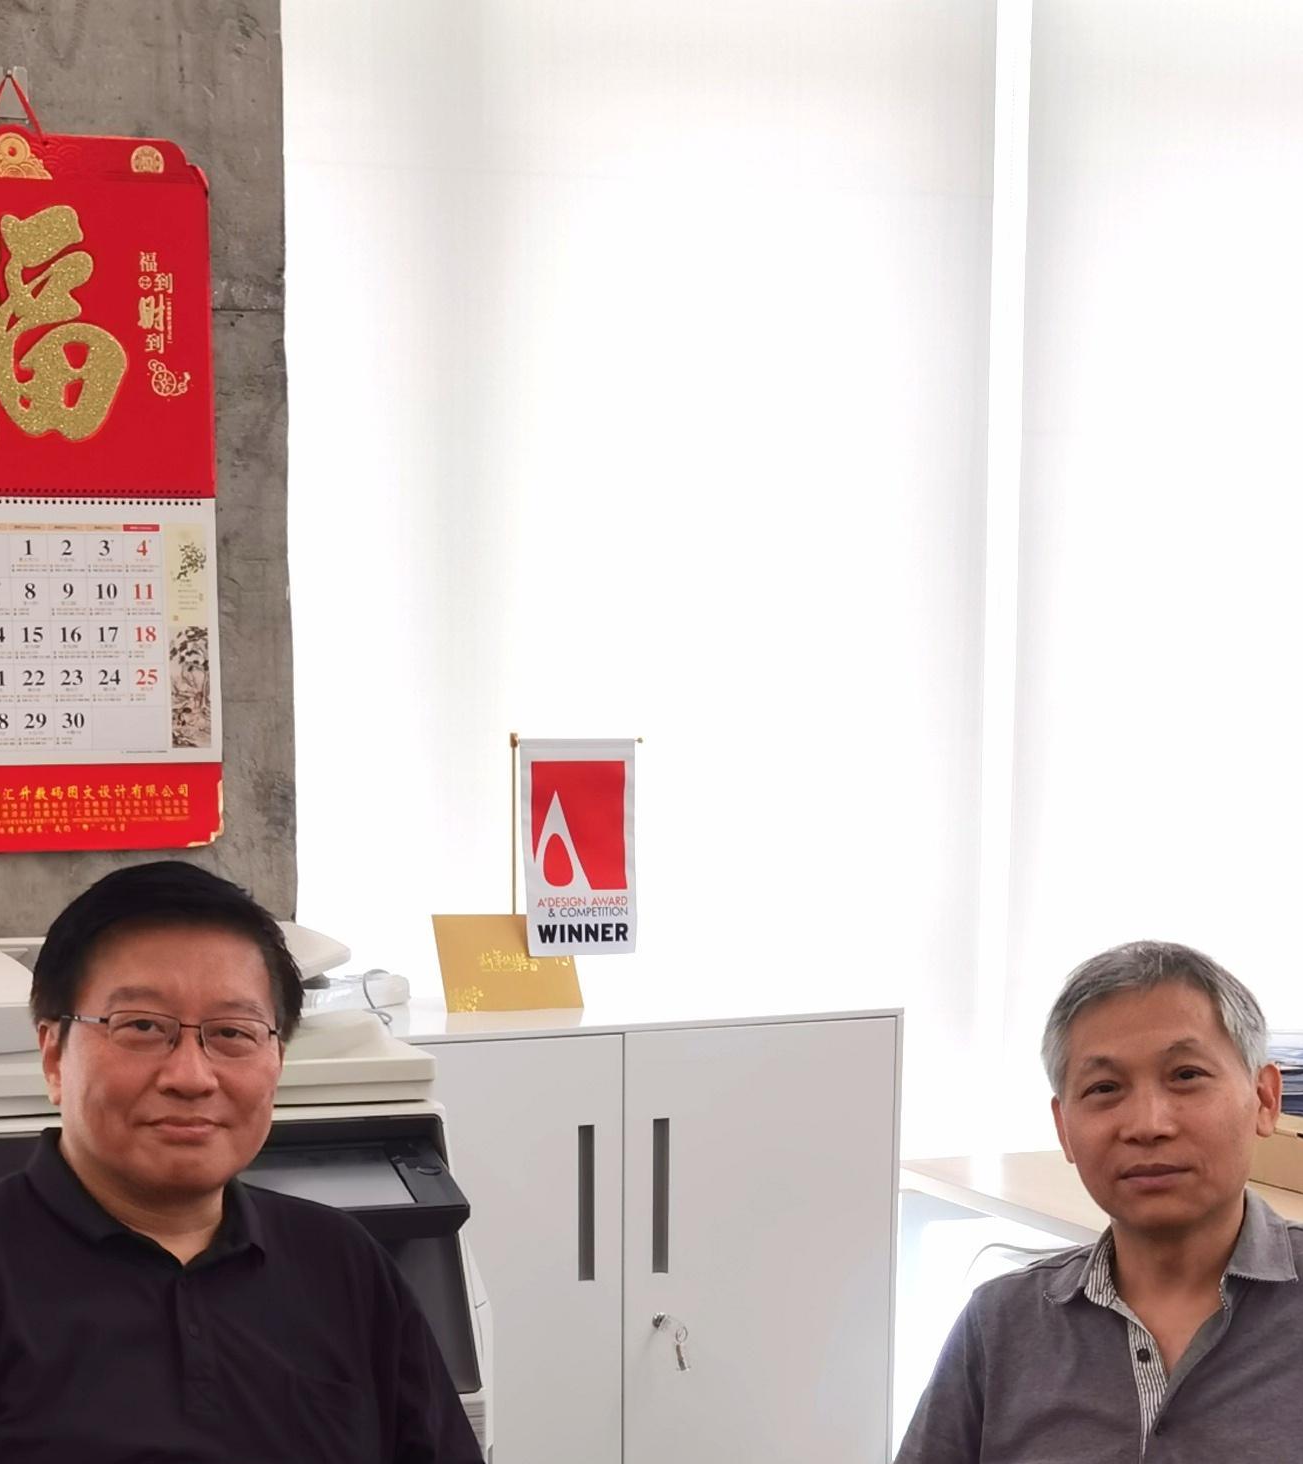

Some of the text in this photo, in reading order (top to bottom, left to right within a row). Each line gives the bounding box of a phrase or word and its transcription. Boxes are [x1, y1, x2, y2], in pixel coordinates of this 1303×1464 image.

[25, 540, 148, 556] 1 2 3 4
[24, 583, 36, 600] 8
[63, 583, 74, 599] 9
[96, 583, 118, 599] 10
[134, 584, 153, 600] 11
[21, 626, 44, 642] 15
[60, 626, 82, 642] 16
[98, 626, 119, 642] 17
[135, 626, 157, 642] 18
[22, 670, 46, 686] 22
[60, 670, 84, 686] 23
[98, 669, 122, 686] 24
[136, 669, 158, 686] 25
[24, 713, 47, 729] 29
[62, 712, 85, 729] 30
[592, 896, 628, 906] AWARD
[548, 906, 629, 918] & COMPETITION
[537, 922, 629, 944] WINNER
